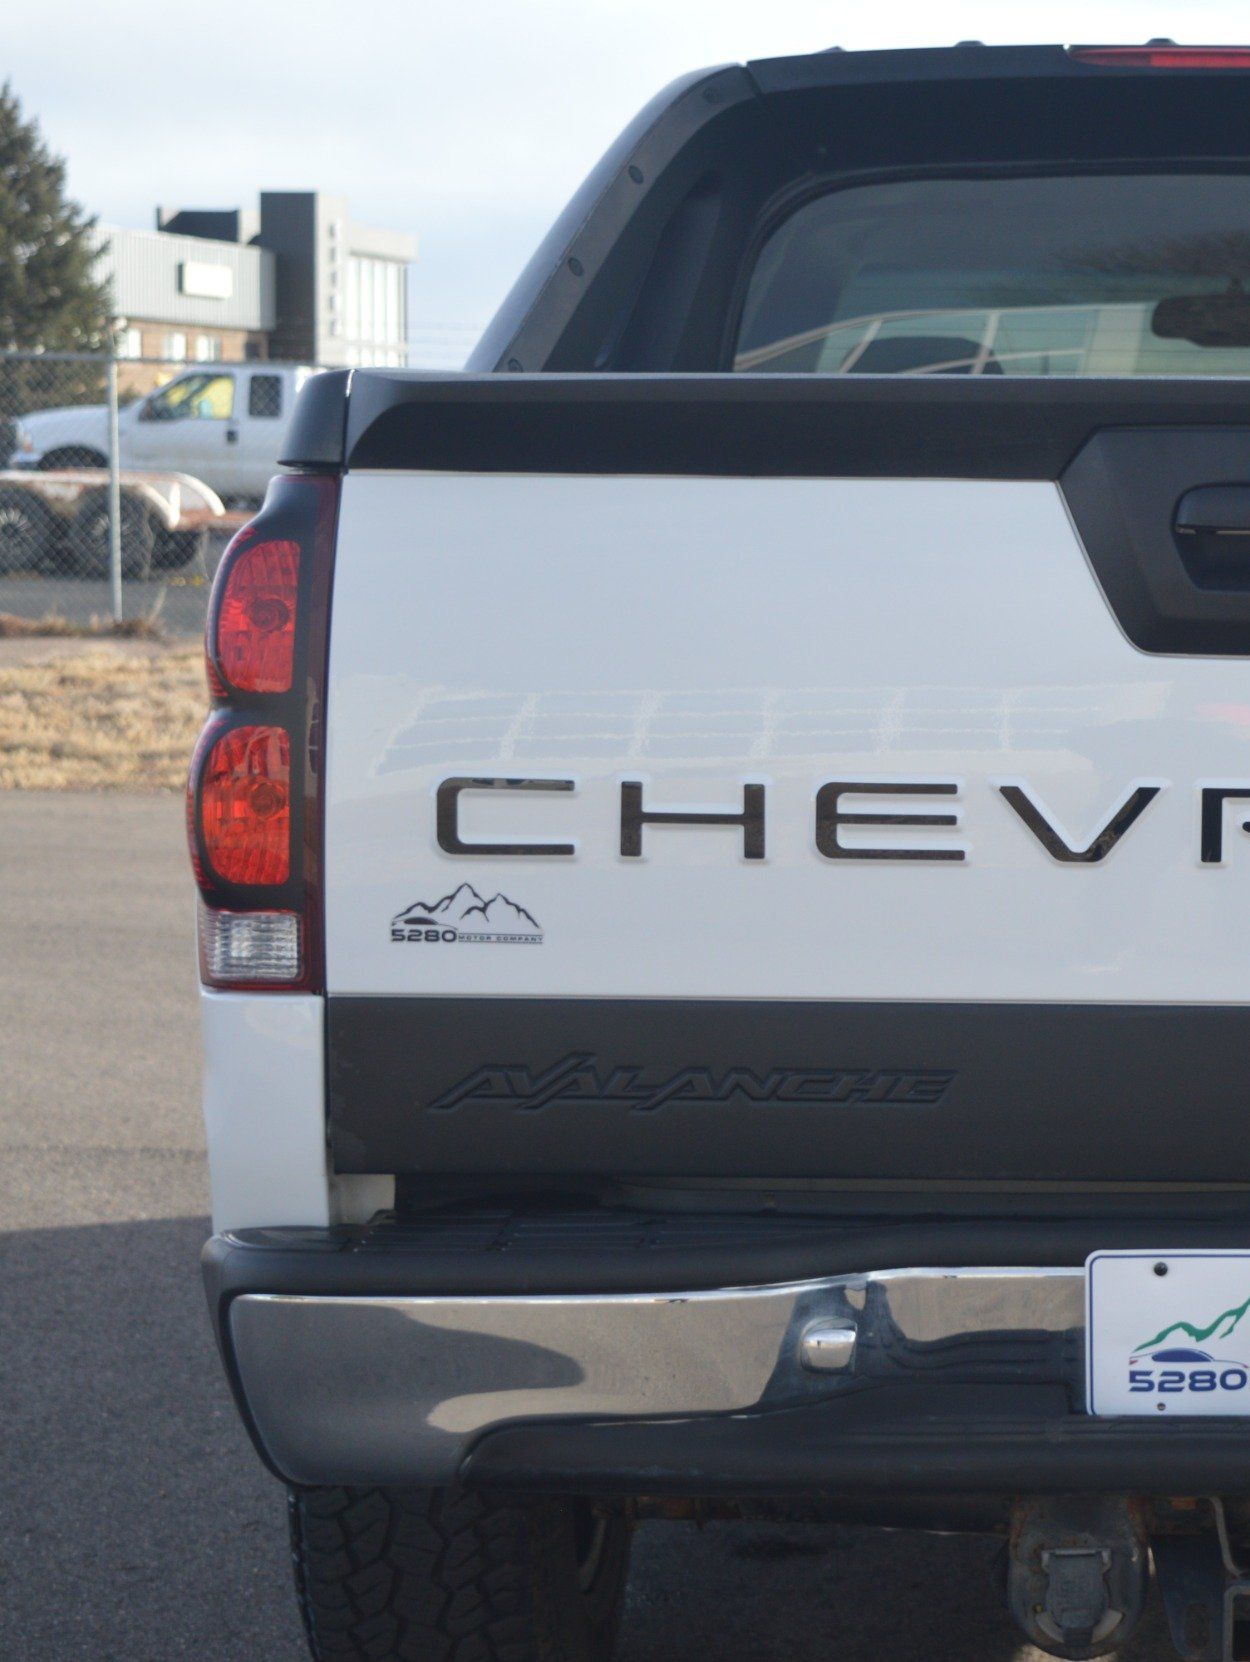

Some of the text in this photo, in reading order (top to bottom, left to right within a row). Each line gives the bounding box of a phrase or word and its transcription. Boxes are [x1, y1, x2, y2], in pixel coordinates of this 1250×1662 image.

[390, 928, 543, 943] 5280 MOTOR COMPANY
[429, 1051, 959, 1112] AVALANCHE
[1128, 1368, 1248, 1393] 5280
